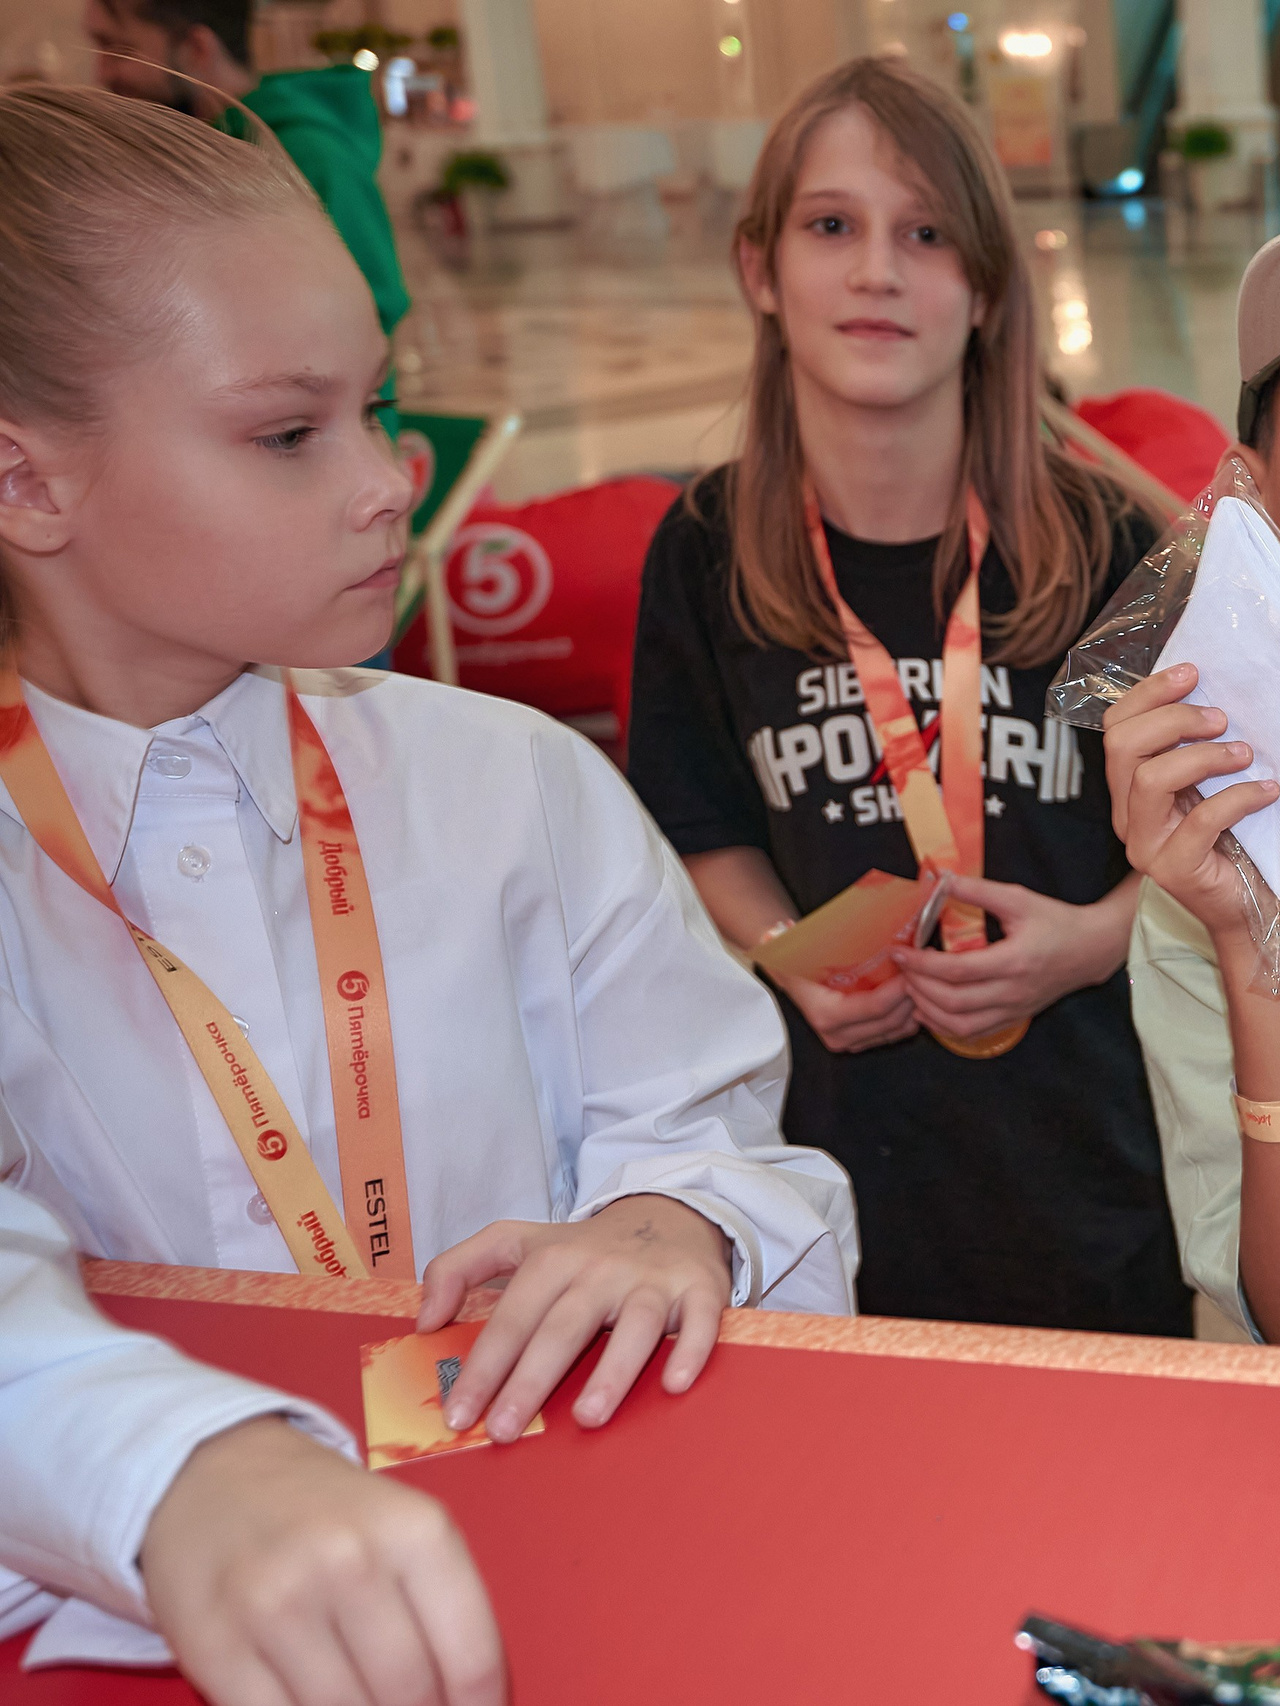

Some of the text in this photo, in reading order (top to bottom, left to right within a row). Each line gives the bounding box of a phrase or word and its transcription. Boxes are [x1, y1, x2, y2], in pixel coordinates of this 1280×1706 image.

[796, 656, 1014, 716] SIBRIN
[318, 840, 355, 916] Добрый
[205, 1021, 269, 1128] Пятёрочка
[347, 1005, 371, 1120] Пятёрочка
[364, 1178, 391, 1268] ESTEL
